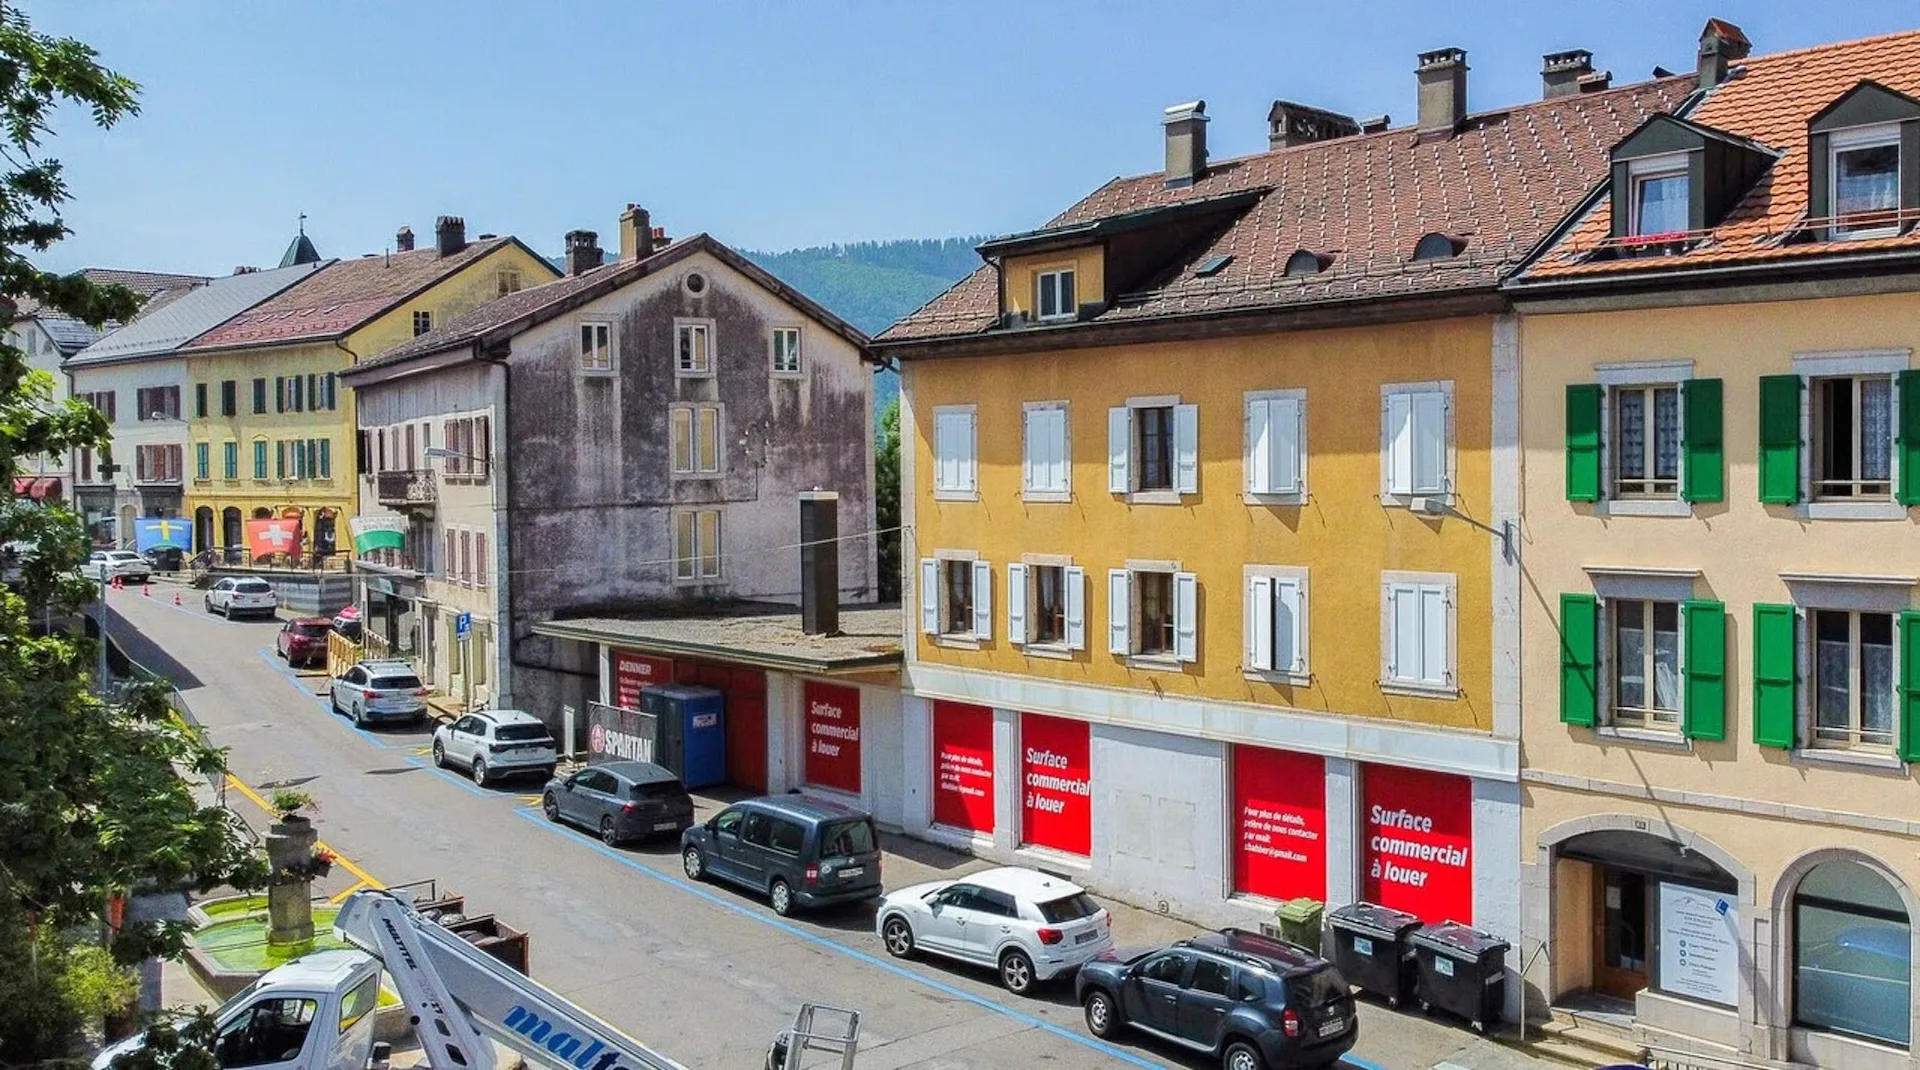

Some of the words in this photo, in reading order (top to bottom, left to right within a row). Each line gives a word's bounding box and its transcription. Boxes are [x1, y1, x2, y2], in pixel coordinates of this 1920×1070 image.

[619, 660, 652, 676] DENNER
[811, 701, 842, 719] Surface
[812, 723, 859, 741] commercial
[605, 730, 652, 763] SPARTAN
[818, 740, 840, 757] louer
[1026, 747, 1068, 770] Surface
[1027, 773, 1092, 797] commercial
[1026, 791, 1034, 808] à
[1035, 793, 1065, 814] louer
[1258, 810, 1273, 820] plus
[1273, 812, 1281, 822] de
[1371, 805, 1433, 833] Surface
[1263, 822, 1272, 832] de
[1271, 825, 1288, 835] nous
[1288, 828, 1319, 840] contacter
[1371, 836, 1468, 867] commercial
[1371, 859, 1381, 878] à
[1384, 861, 1428, 887] louer
[382, 918, 418, 971] MULTITEL
